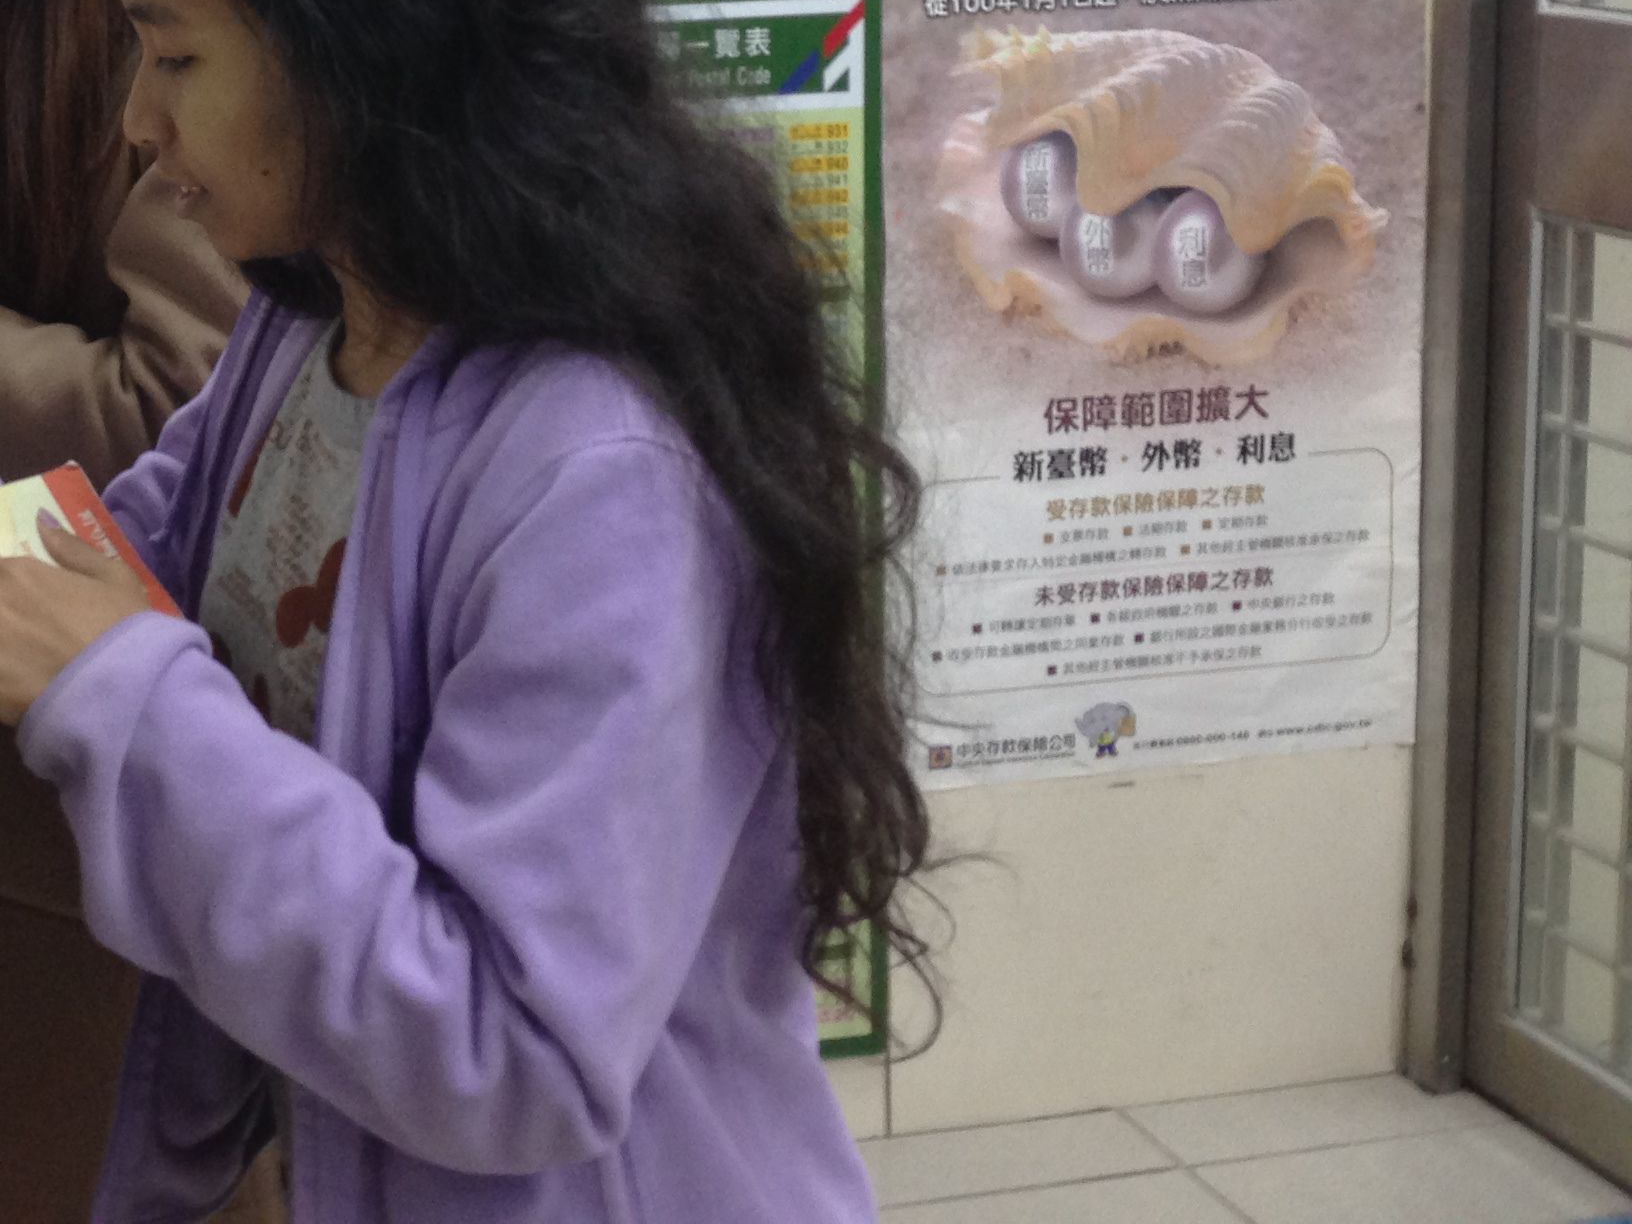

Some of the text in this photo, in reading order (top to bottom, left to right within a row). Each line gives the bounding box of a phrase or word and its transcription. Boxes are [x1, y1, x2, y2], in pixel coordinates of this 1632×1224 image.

[1179, 227, 1208, 288] 利息
[1043, 383, 1270, 434] 保障範圍擴大
[1012, 431, 1297, 483] 新臺幣 外幣 利息
[1045, 482, 1266, 522] 受存款保險保障之存款
[1034, 566, 1274, 607] 未受存款保險保障之存款
